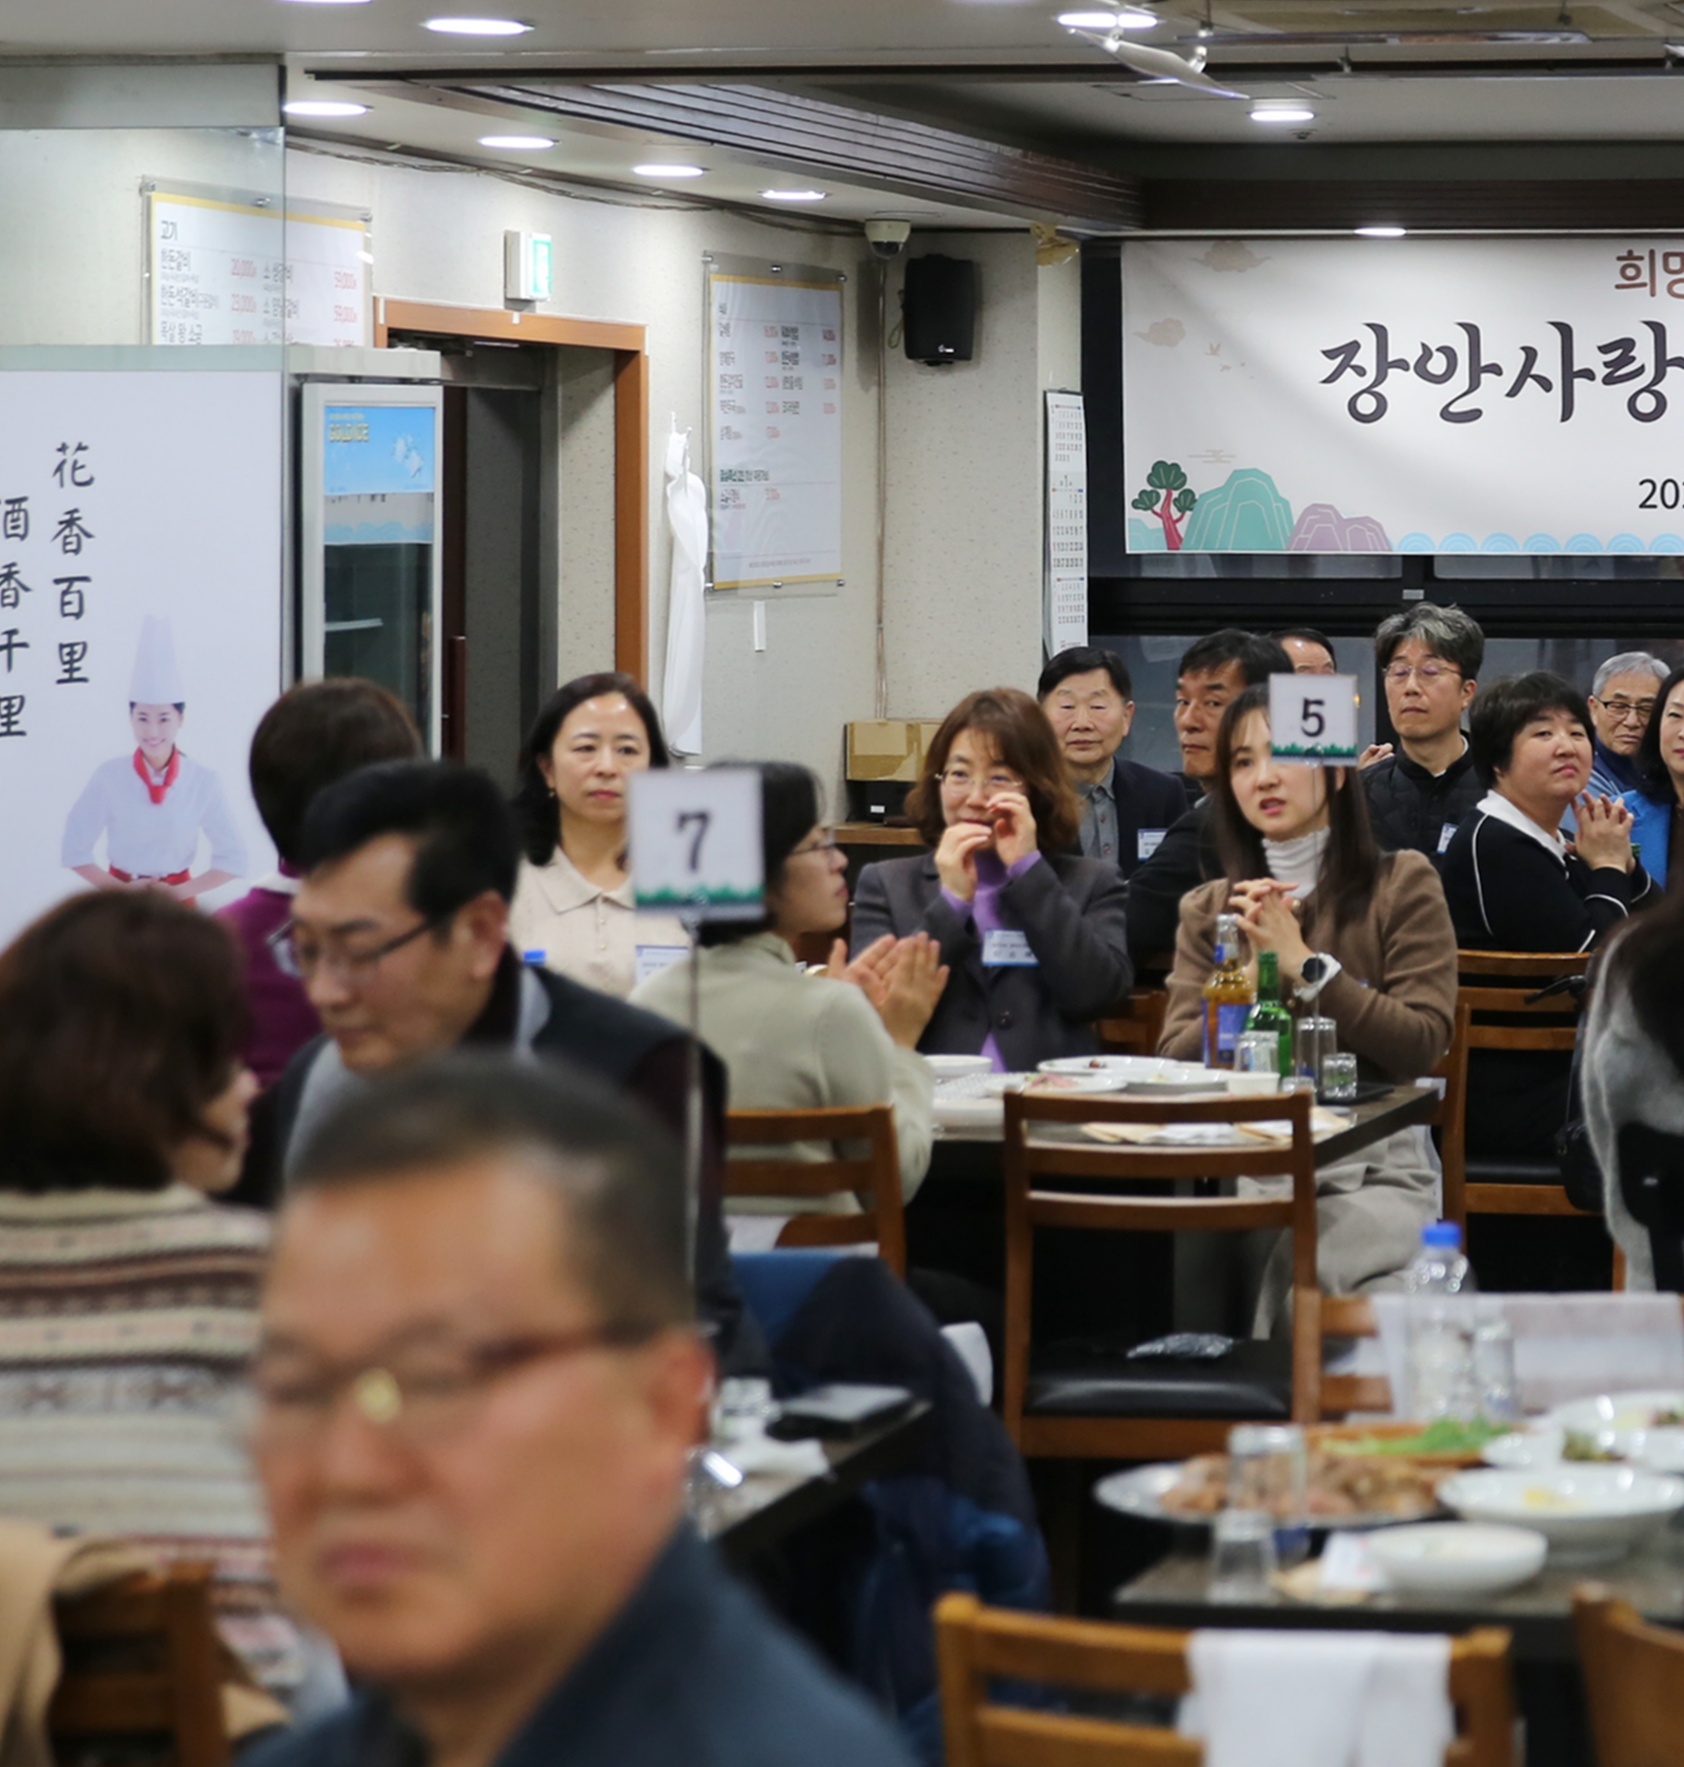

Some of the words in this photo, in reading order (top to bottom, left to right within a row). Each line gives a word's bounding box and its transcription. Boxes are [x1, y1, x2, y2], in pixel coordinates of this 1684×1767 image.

[52, 442, 95, 685] 花香百里
[1301, 698, 1326, 738] 5
[676, 811, 712, 873] 7
